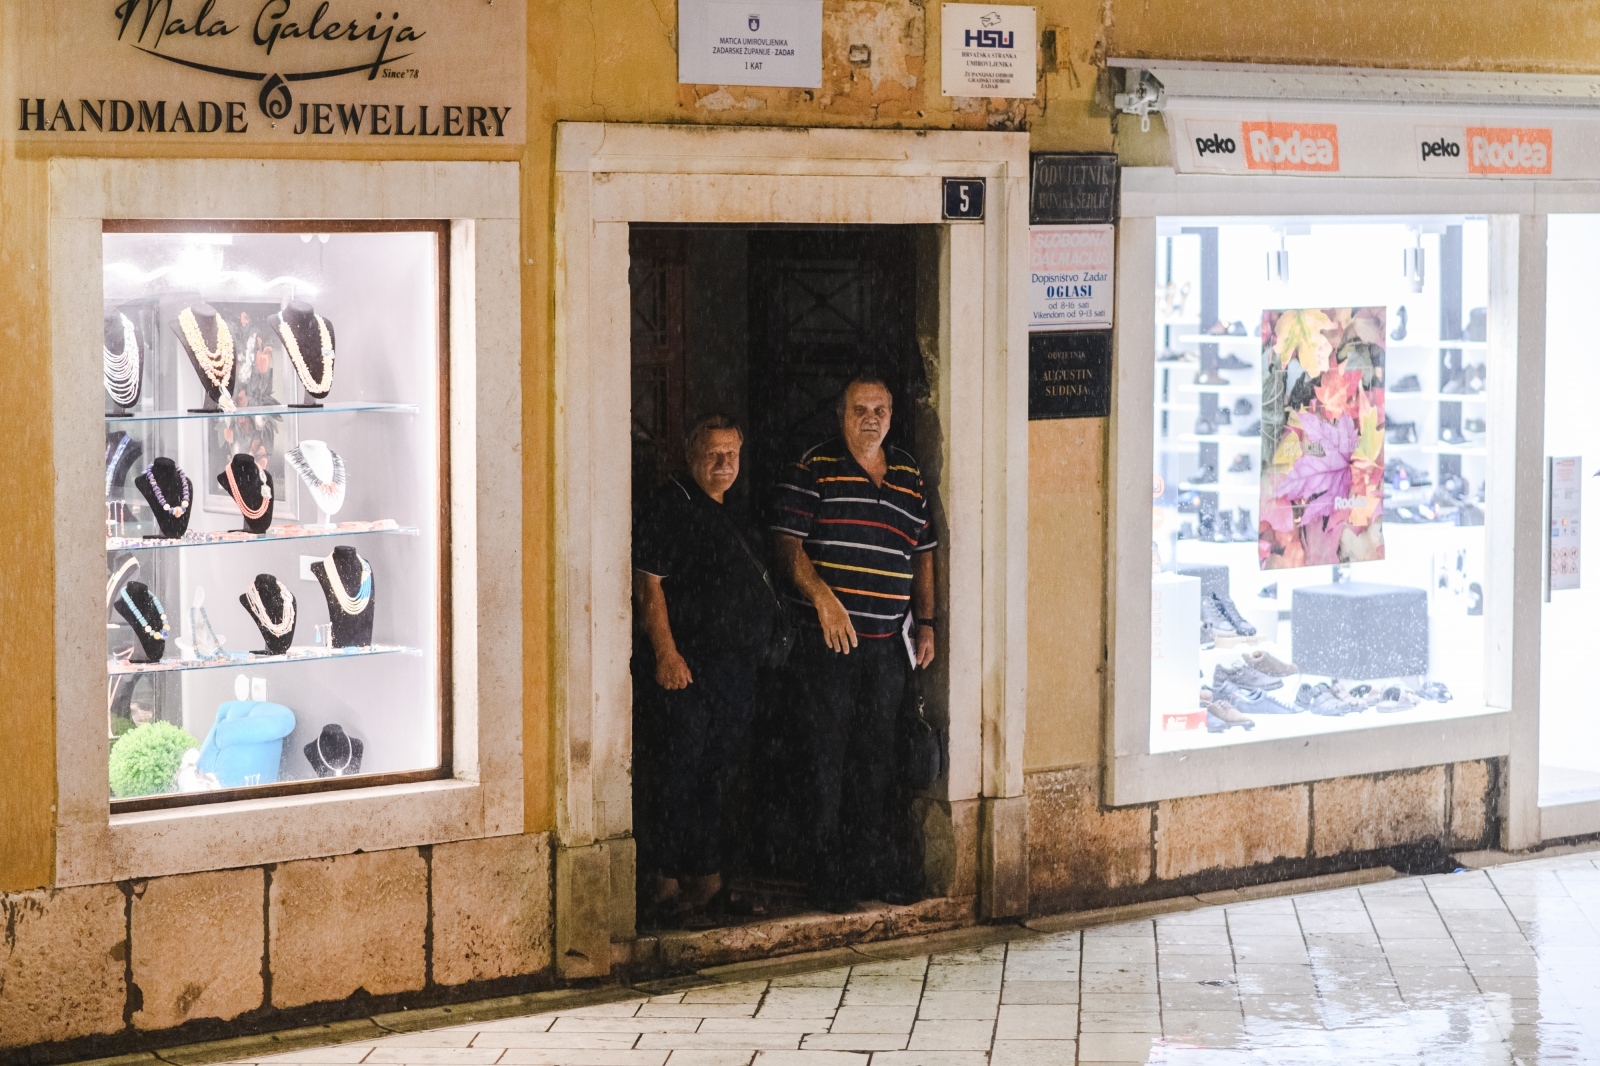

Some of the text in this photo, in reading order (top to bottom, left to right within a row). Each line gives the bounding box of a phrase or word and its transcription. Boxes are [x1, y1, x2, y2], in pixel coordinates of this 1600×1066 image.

[115, 0, 427, 81] Mala Galerija
[719, 37, 788, 46] MATICA UMIROVLJENIKA
[965, 29, 1014, 49] HSU
[712, 46, 743, 55] ZADARSKE
[744, 46, 771, 55] ŽUPANIJE
[775, 48, 795, 56] ZADAR
[750, 62, 763, 70] KAT
[18, 98, 512, 137] HANDMADE JEWELLERY
[1195, 130, 1334, 165] peko Rodea
[1421, 134, 1547, 168] peko Rodea
[1039, 165, 1109, 186] ODVJETNIK
[959, 185, 970, 212] 5
[1036, 233, 1108, 248] SLOBODNA
[1032, 251, 1109, 266] DALMACIJA
[1083, 272, 1108, 282] Zadar
[1046, 285, 1092, 298] OGLASI
[1033, 309, 1106, 319] Vikendom od 9-13 sati
[1042, 369, 1093, 381] AUGUSTIN
[1045, 384, 1088, 396] SUDINJA
[1334, 494, 1367, 510] Rodea
